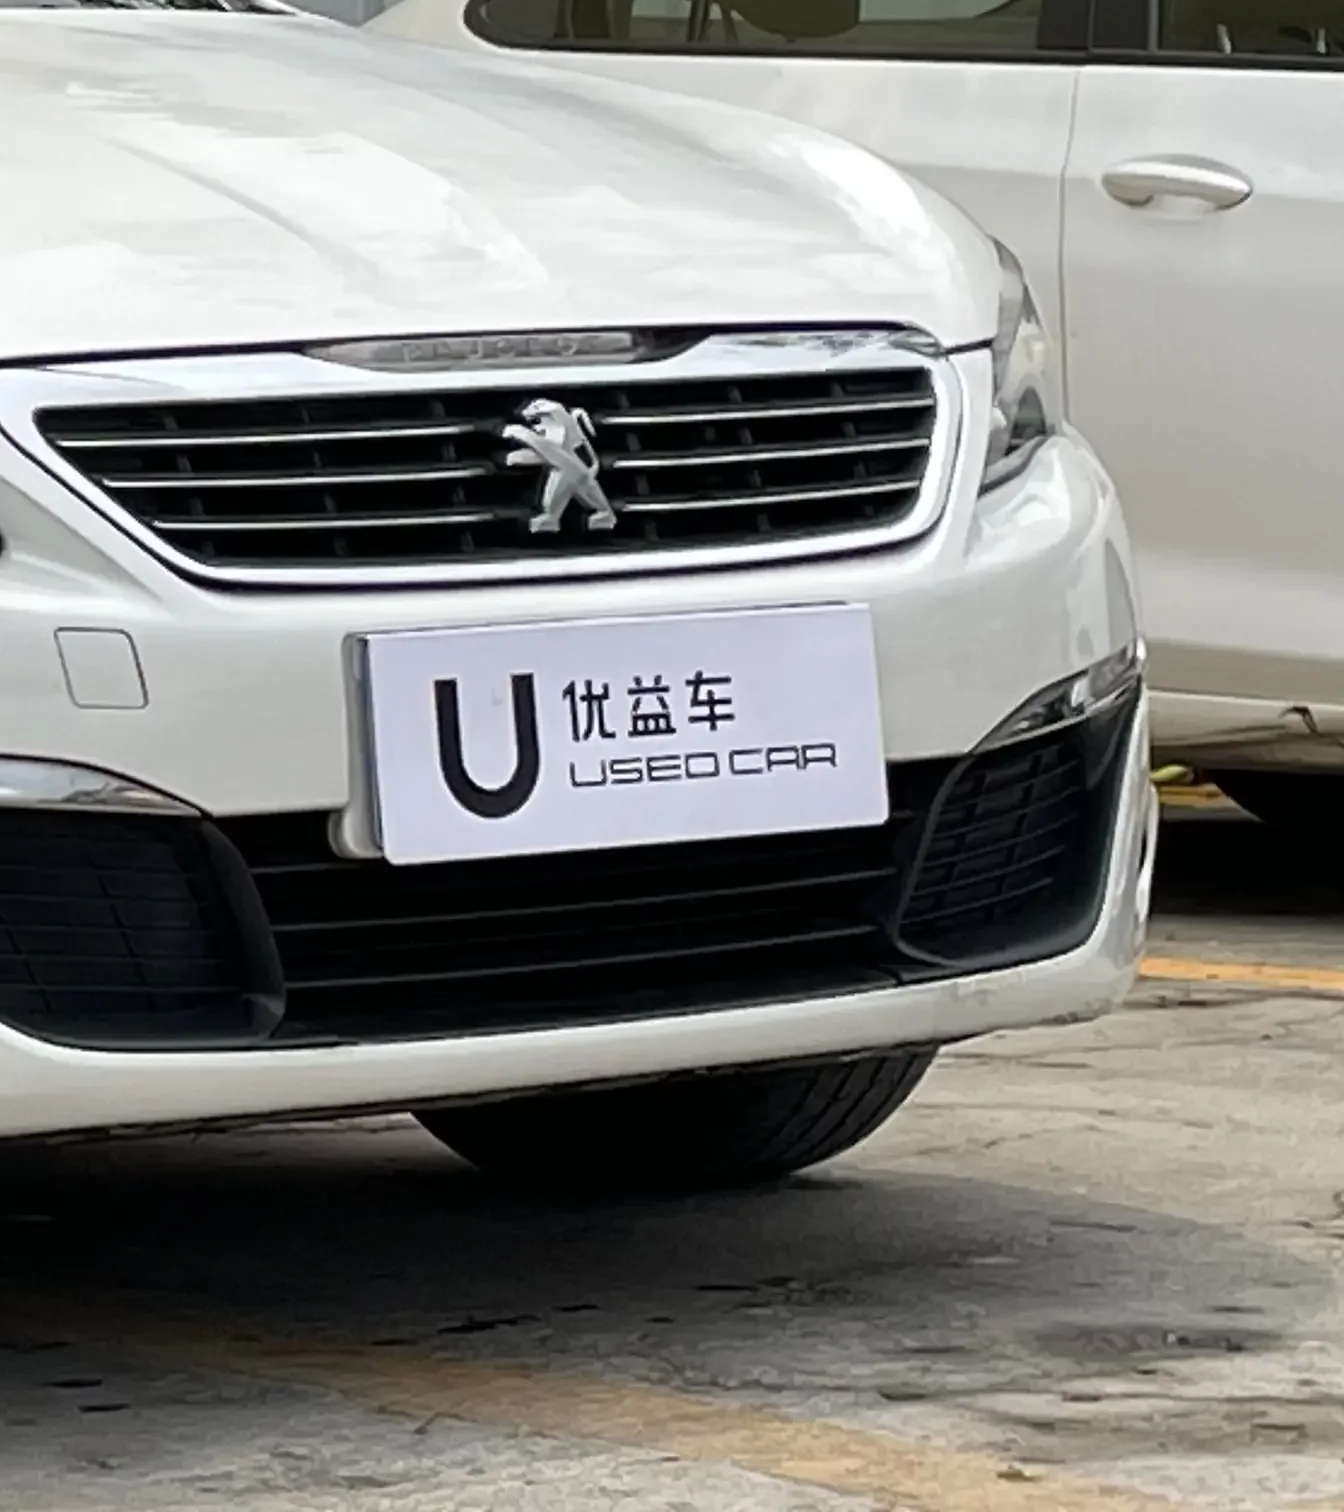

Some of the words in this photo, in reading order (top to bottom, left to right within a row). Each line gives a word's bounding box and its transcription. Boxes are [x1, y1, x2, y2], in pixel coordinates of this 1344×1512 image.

[561, 670, 736, 743] 优益车
[433, 672, 541, 819] U
[569, 751, 721, 788] USED
[728, 742, 838, 776] CAR
